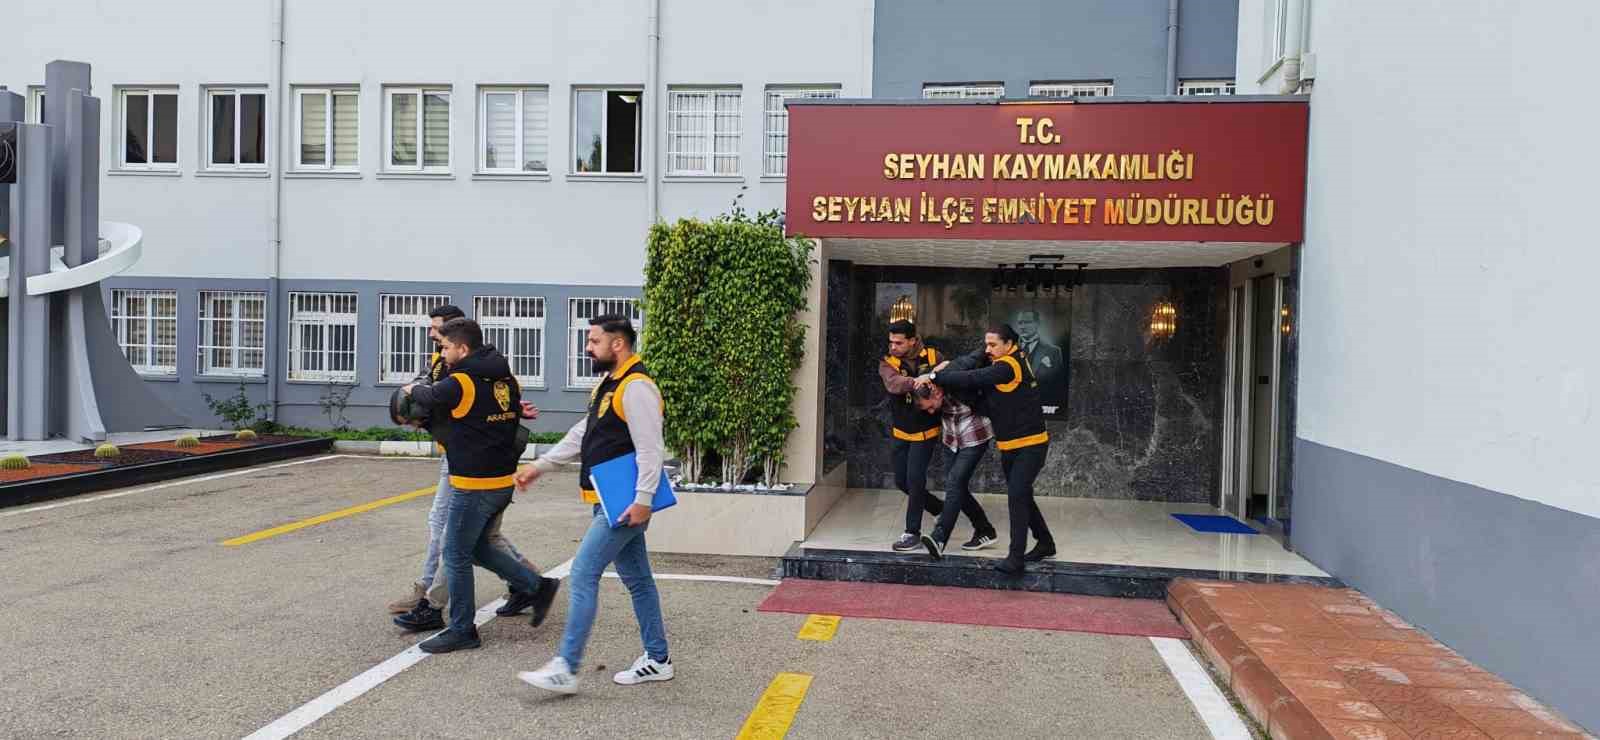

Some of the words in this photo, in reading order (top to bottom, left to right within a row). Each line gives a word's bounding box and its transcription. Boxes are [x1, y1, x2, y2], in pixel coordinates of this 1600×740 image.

[1017, 117, 1061, 144] T.C.
[884, 153, 985, 180] SEYHAN
[993, 150, 1194, 180] KAYMAKAMLIĞI
[812, 196, 911, 223] SEYHAN
[920, 192, 974, 228] İLÇE
[982, 193, 1096, 224] EMNİYET
[1104, 194, 1275, 225] MÜDÜRLÜĞÜ
